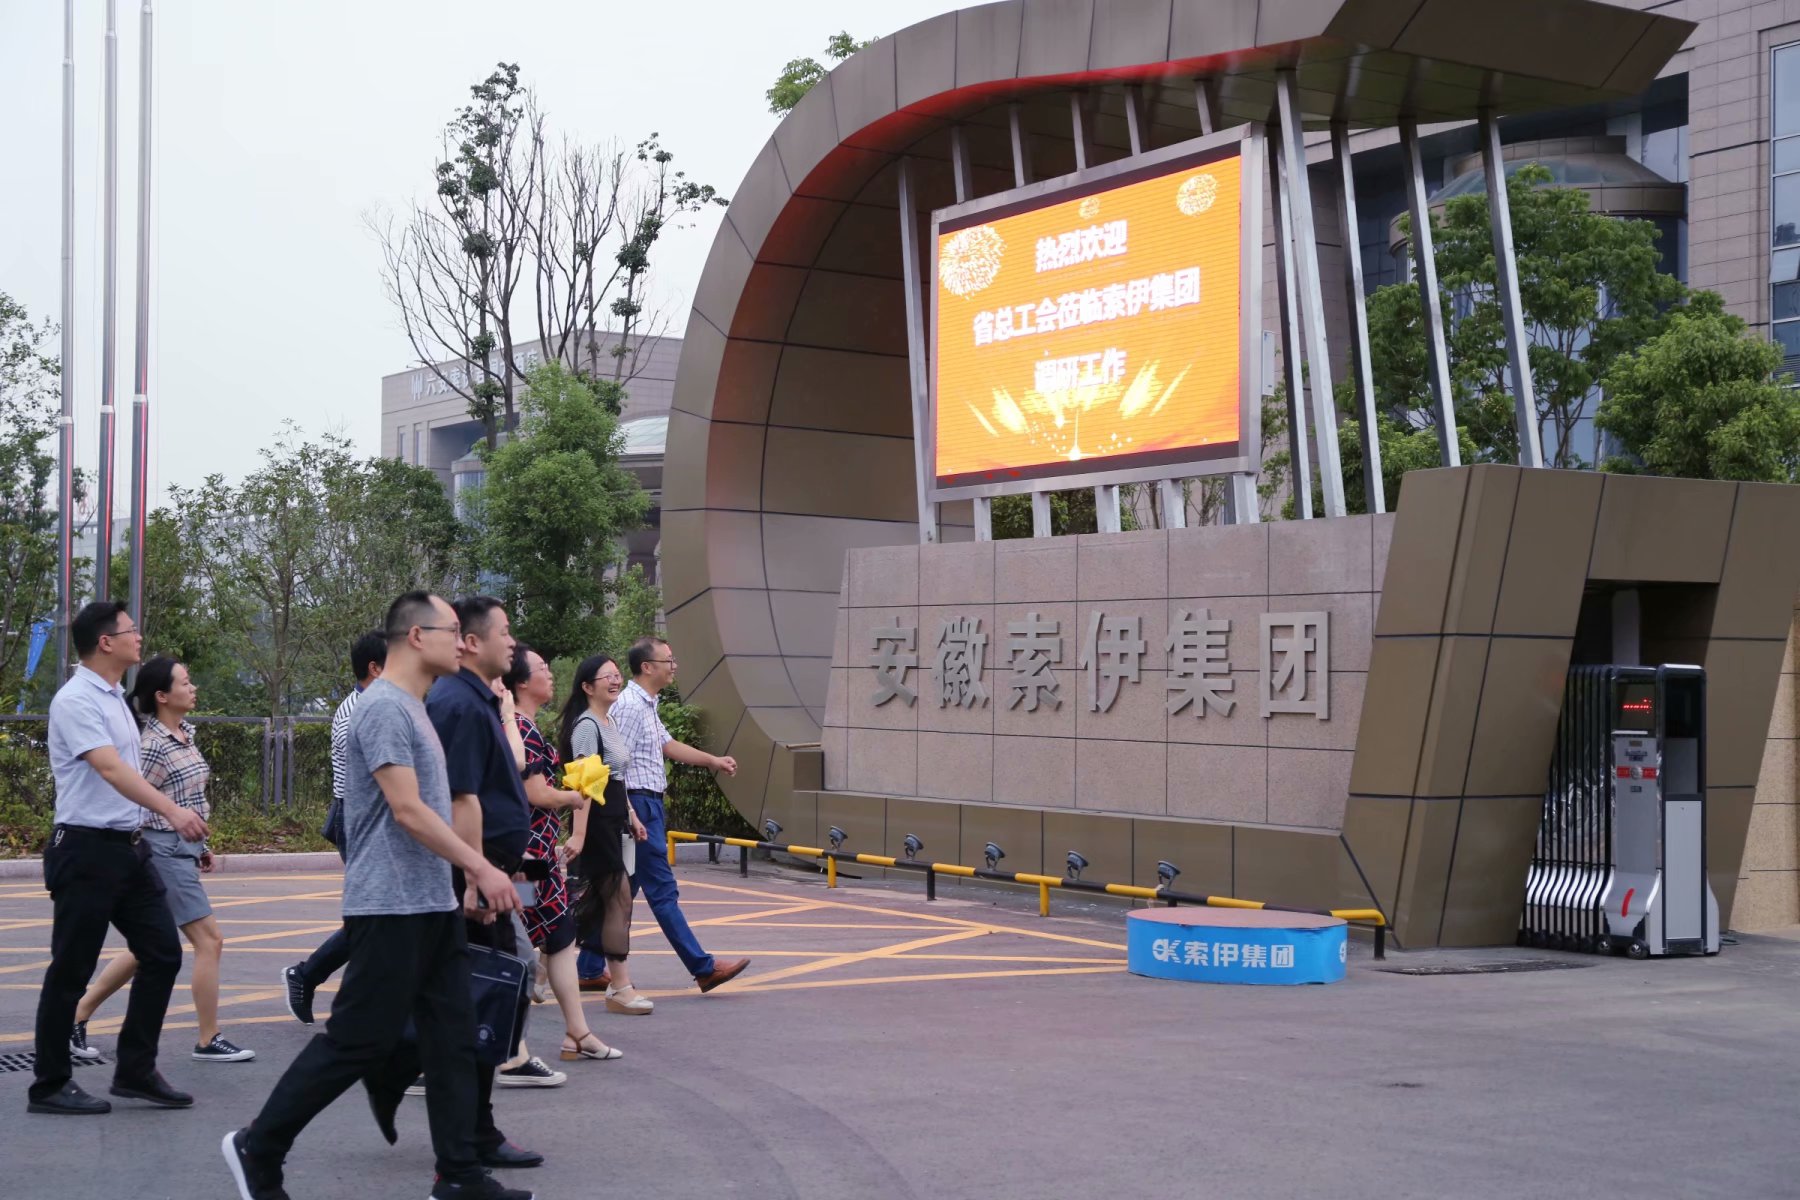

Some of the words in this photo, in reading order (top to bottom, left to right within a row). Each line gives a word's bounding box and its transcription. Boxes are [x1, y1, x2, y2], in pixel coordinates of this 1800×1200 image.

[1035, 219, 1128, 273] 热烈欢迎
[973, 267, 1201, 346] 省总工会莅临索伊集团
[869, 607, 1332, 720] 安徽索伊集团
[1184, 941, 1295, 969] 索伊集团
